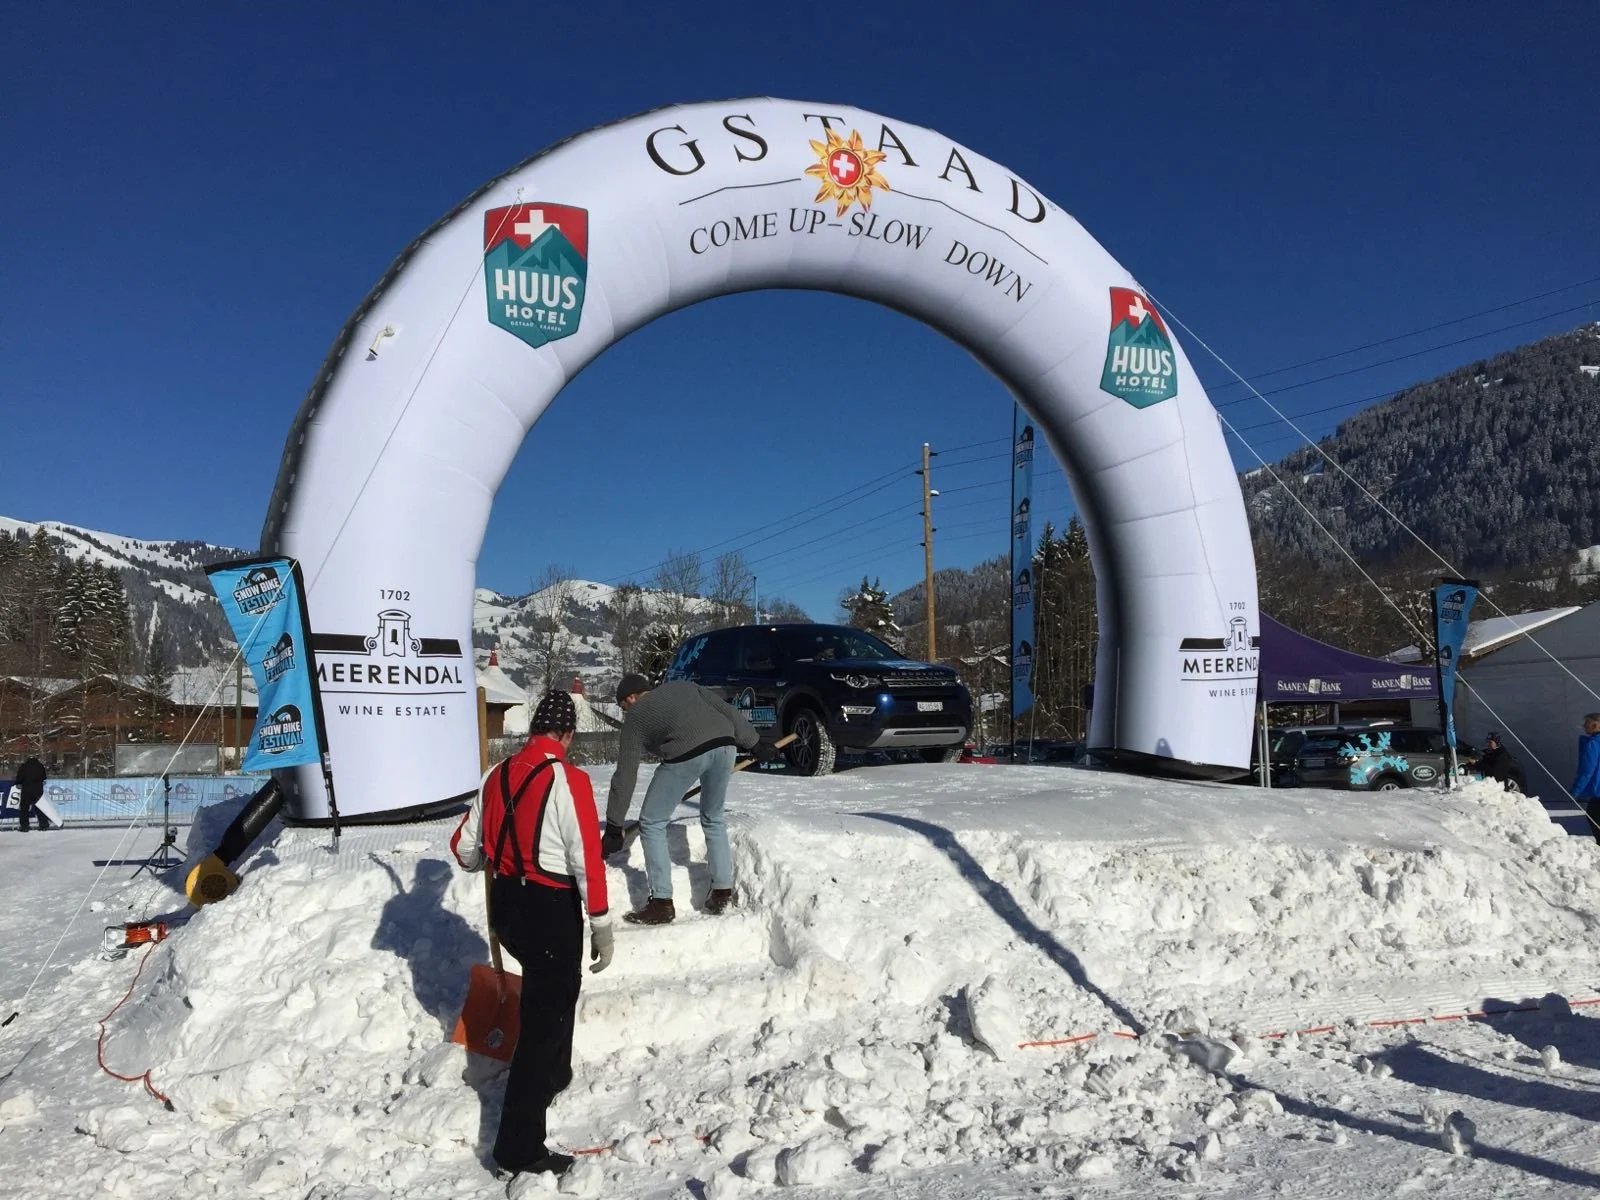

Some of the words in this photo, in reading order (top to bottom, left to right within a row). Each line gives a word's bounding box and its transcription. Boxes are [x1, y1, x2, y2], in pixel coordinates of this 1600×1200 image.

[646, 113, 1048, 225] GSTAAD
[689, 212, 778, 255] COME
[944, 240, 1033, 303] DOWN
[494, 268, 580, 310] HUUS
[505, 304, 567, 325] HOTEL
[1111, 345, 1173, 377] HUUS
[1115, 375, 1168, 389] HOTEL
[234, 583, 260, 602] SNOW
[259, 577, 280, 593] BIKE
[379, 589, 411, 601] 1702
[239, 589, 286, 613] FESTIVAL
[1229, 601, 1246, 610] 1702
[1277, 680, 1309, 692] SAANEN
[1321, 681, 1342, 692] BANK
[1371, 678, 1401, 689] SAANEN
[1412, 676, 1432, 686] BANK
[1208, 689, 1236, 697] WINE
[338, 705, 384, 716] WINE
[395, 706, 447, 717] ESTATE
[259, 723, 281, 738] SNOW
[282, 721, 301, 733] BIKE
[258, 731, 304, 750] FESTIVAL
